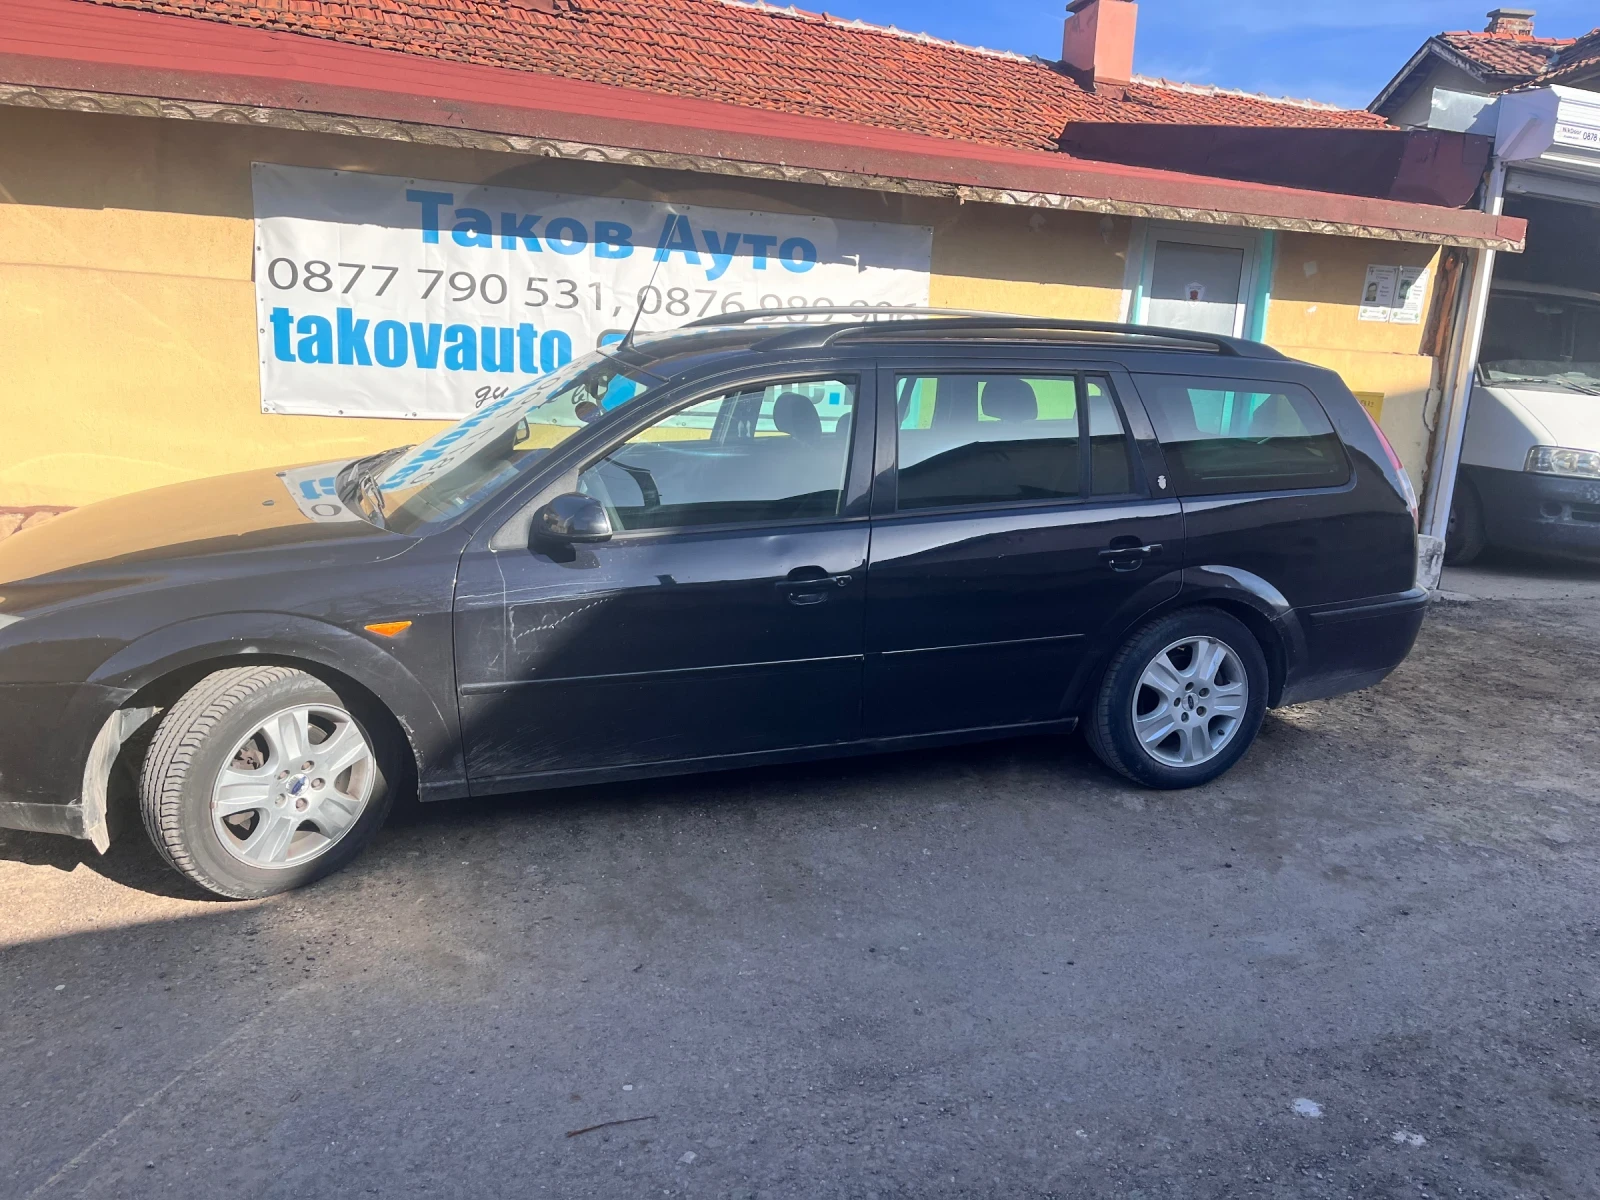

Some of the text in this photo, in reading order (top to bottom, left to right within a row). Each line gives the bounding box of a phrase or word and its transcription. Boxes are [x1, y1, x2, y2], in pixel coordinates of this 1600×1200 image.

[1583, 131, 1598, 141] 0878
[406, 188, 817, 281] Таков Ауто
[267, 257, 399, 296] 0877
[417, 268, 508, 305] 790
[524, 276, 622, 317] 531,
[637, 285, 745, 319] 0876
[269, 306, 572, 375] takovauto
